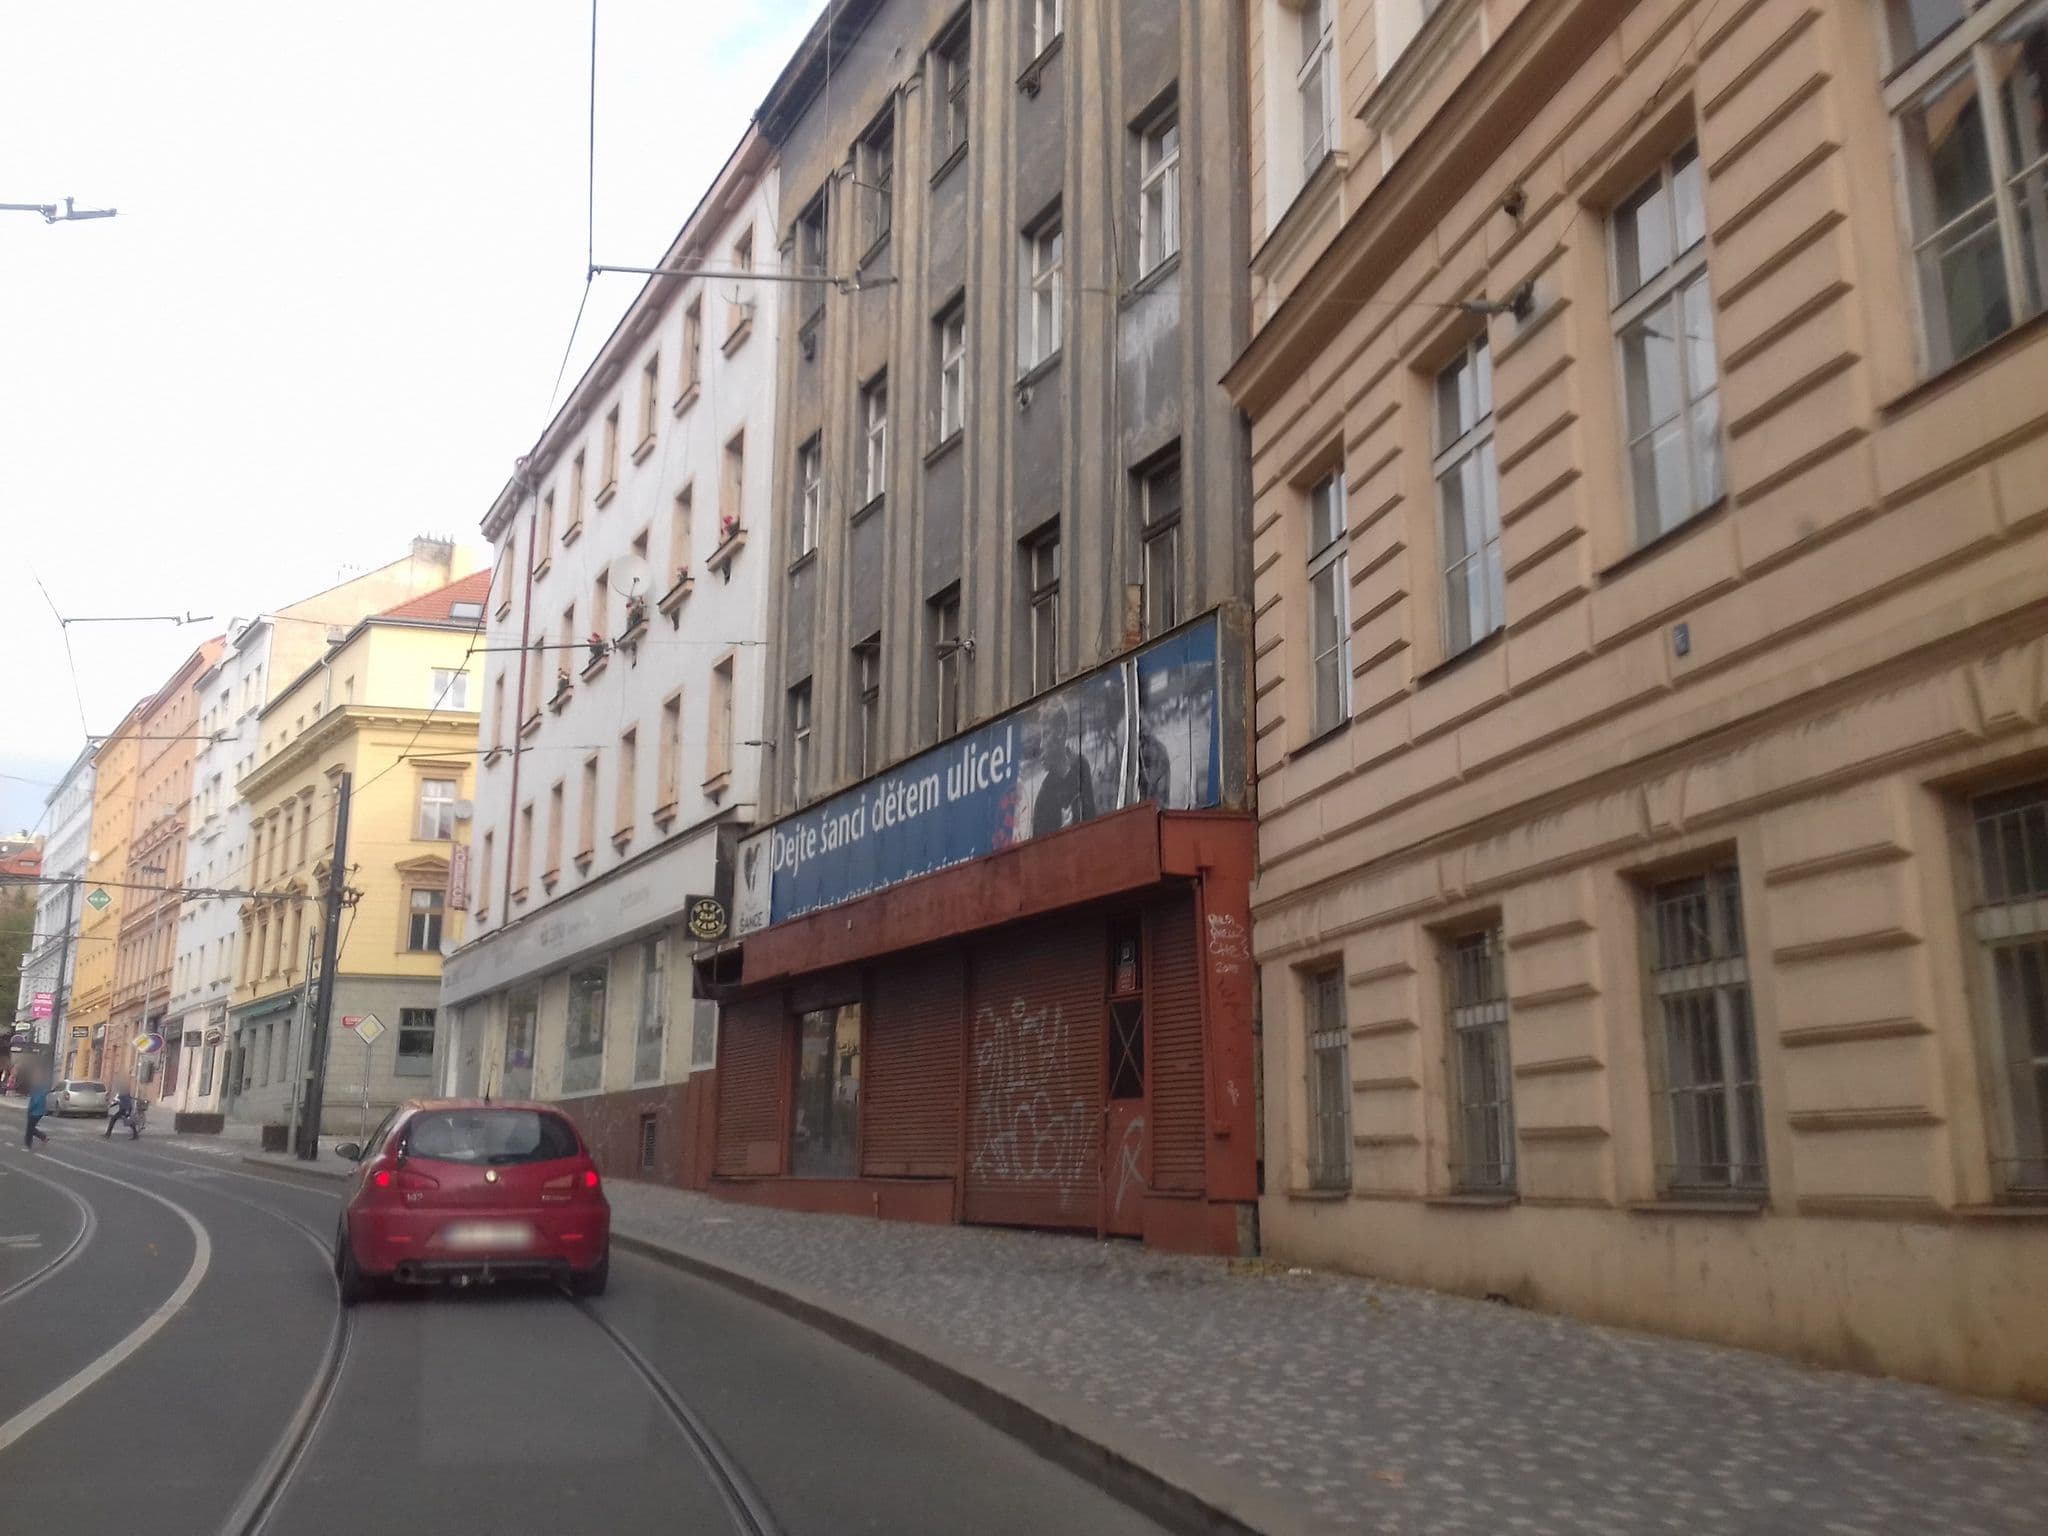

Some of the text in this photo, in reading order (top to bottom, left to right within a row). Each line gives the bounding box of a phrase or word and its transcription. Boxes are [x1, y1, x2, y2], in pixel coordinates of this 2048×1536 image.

[774, 725, 1013, 878] Dejte šanci dětem ulice!
